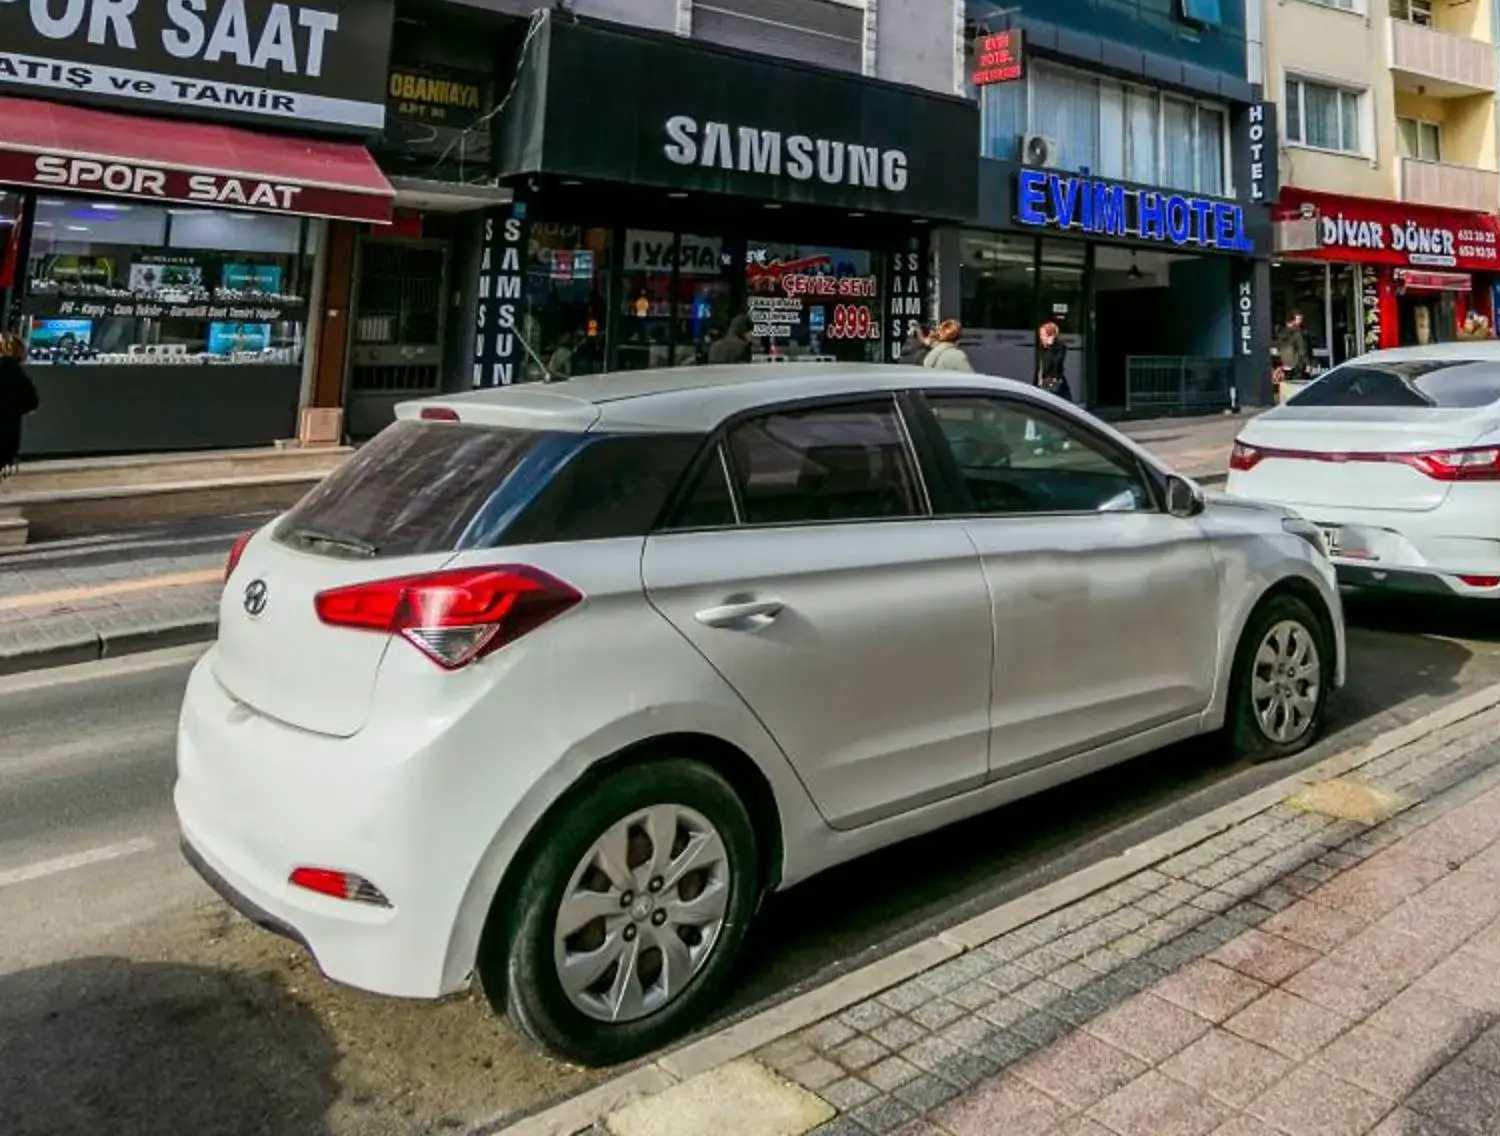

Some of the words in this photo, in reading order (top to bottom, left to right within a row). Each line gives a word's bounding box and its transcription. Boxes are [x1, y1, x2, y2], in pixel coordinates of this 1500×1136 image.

[0, 58, 93, 89] ATIŞ
[108, 74, 156, 94] ve
[172, 78, 296, 114] TAMİR
[34, 154, 167, 197] SPOR
[188, 176, 303, 210] SAAT
[663, 114, 909, 192] SAMSUNG
[1247, 105, 1264, 200] HOTEL
[1017, 166, 1127, 236] EVİM
[1137, 187, 1255, 253] HOTEL
[1322, 212, 1385, 250] DİYAR
[1390, 219, 1456, 256] DÖNER
[1239, 282, 1253, 355] HOTEL
